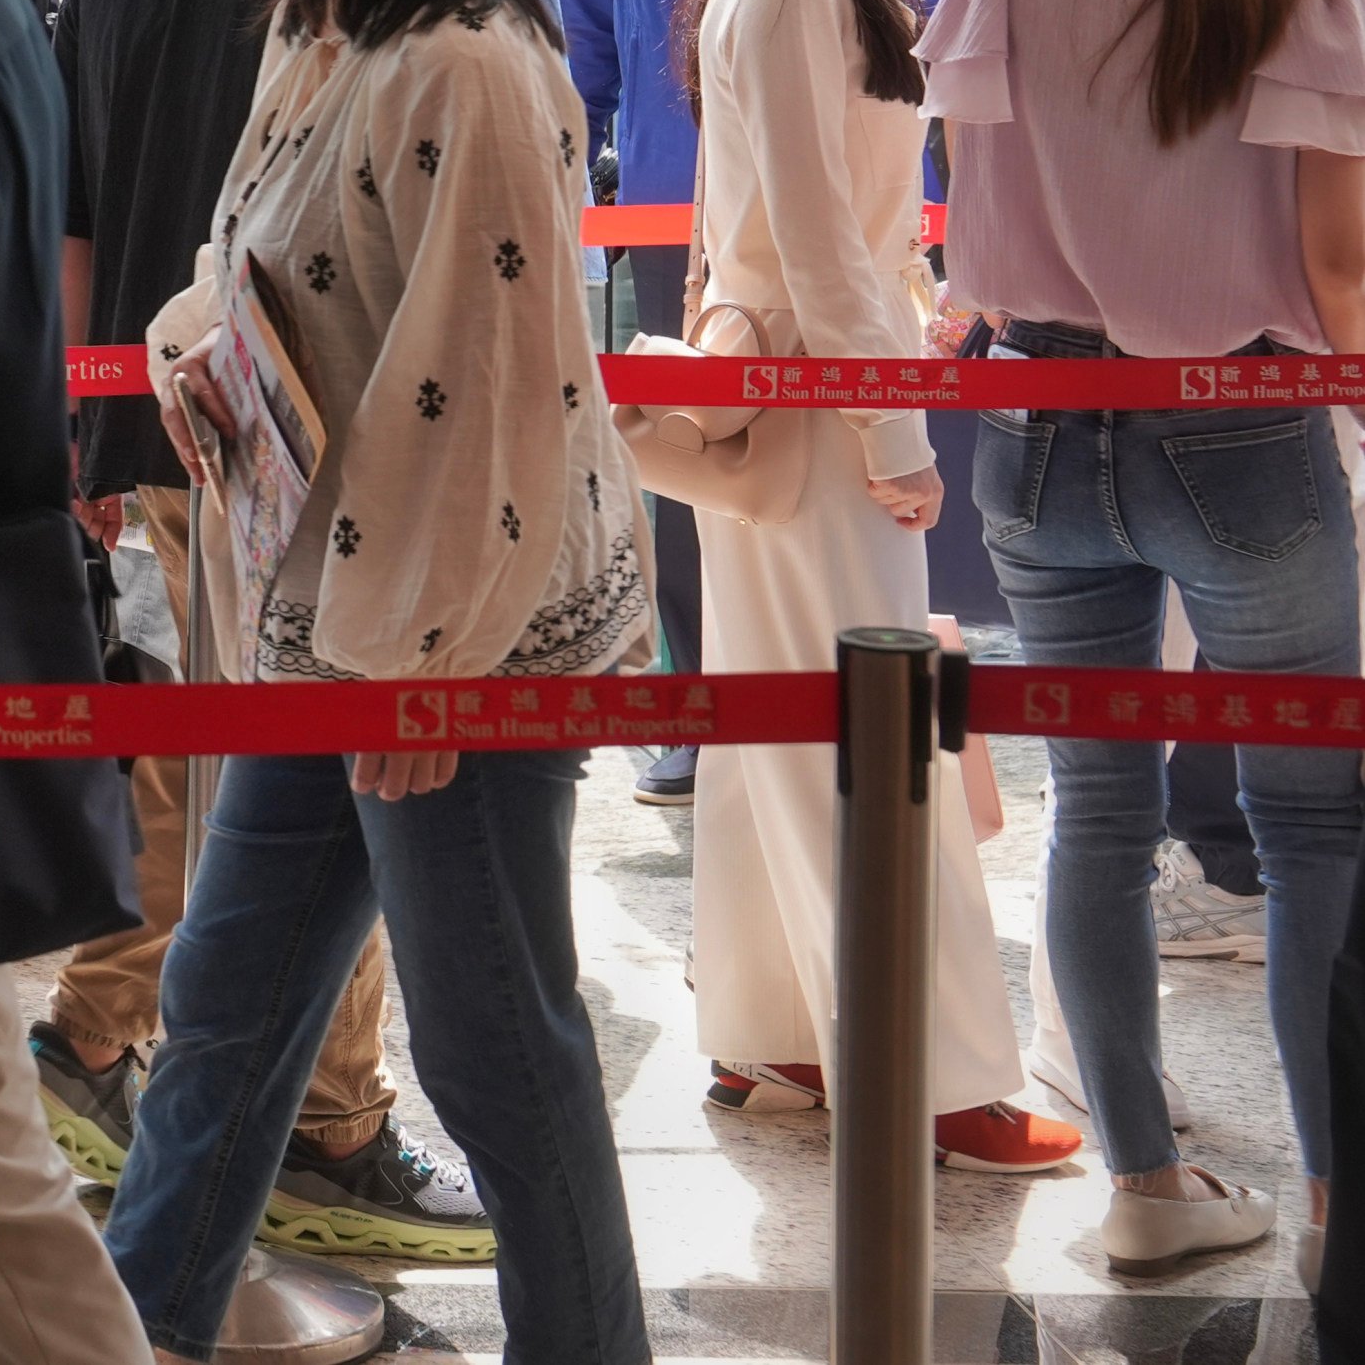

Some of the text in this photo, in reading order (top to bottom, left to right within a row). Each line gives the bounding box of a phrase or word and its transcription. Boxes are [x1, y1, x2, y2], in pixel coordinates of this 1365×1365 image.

[781, 385, 960, 403] Sun Hung Kai Properties
[1220, 385, 1249, 400] Sun
[1253, 384, 1294, 402] Hung
[1298, 383, 1324, 398] Kai
[453, 715, 715, 741] Sun Hung Kai Properties
